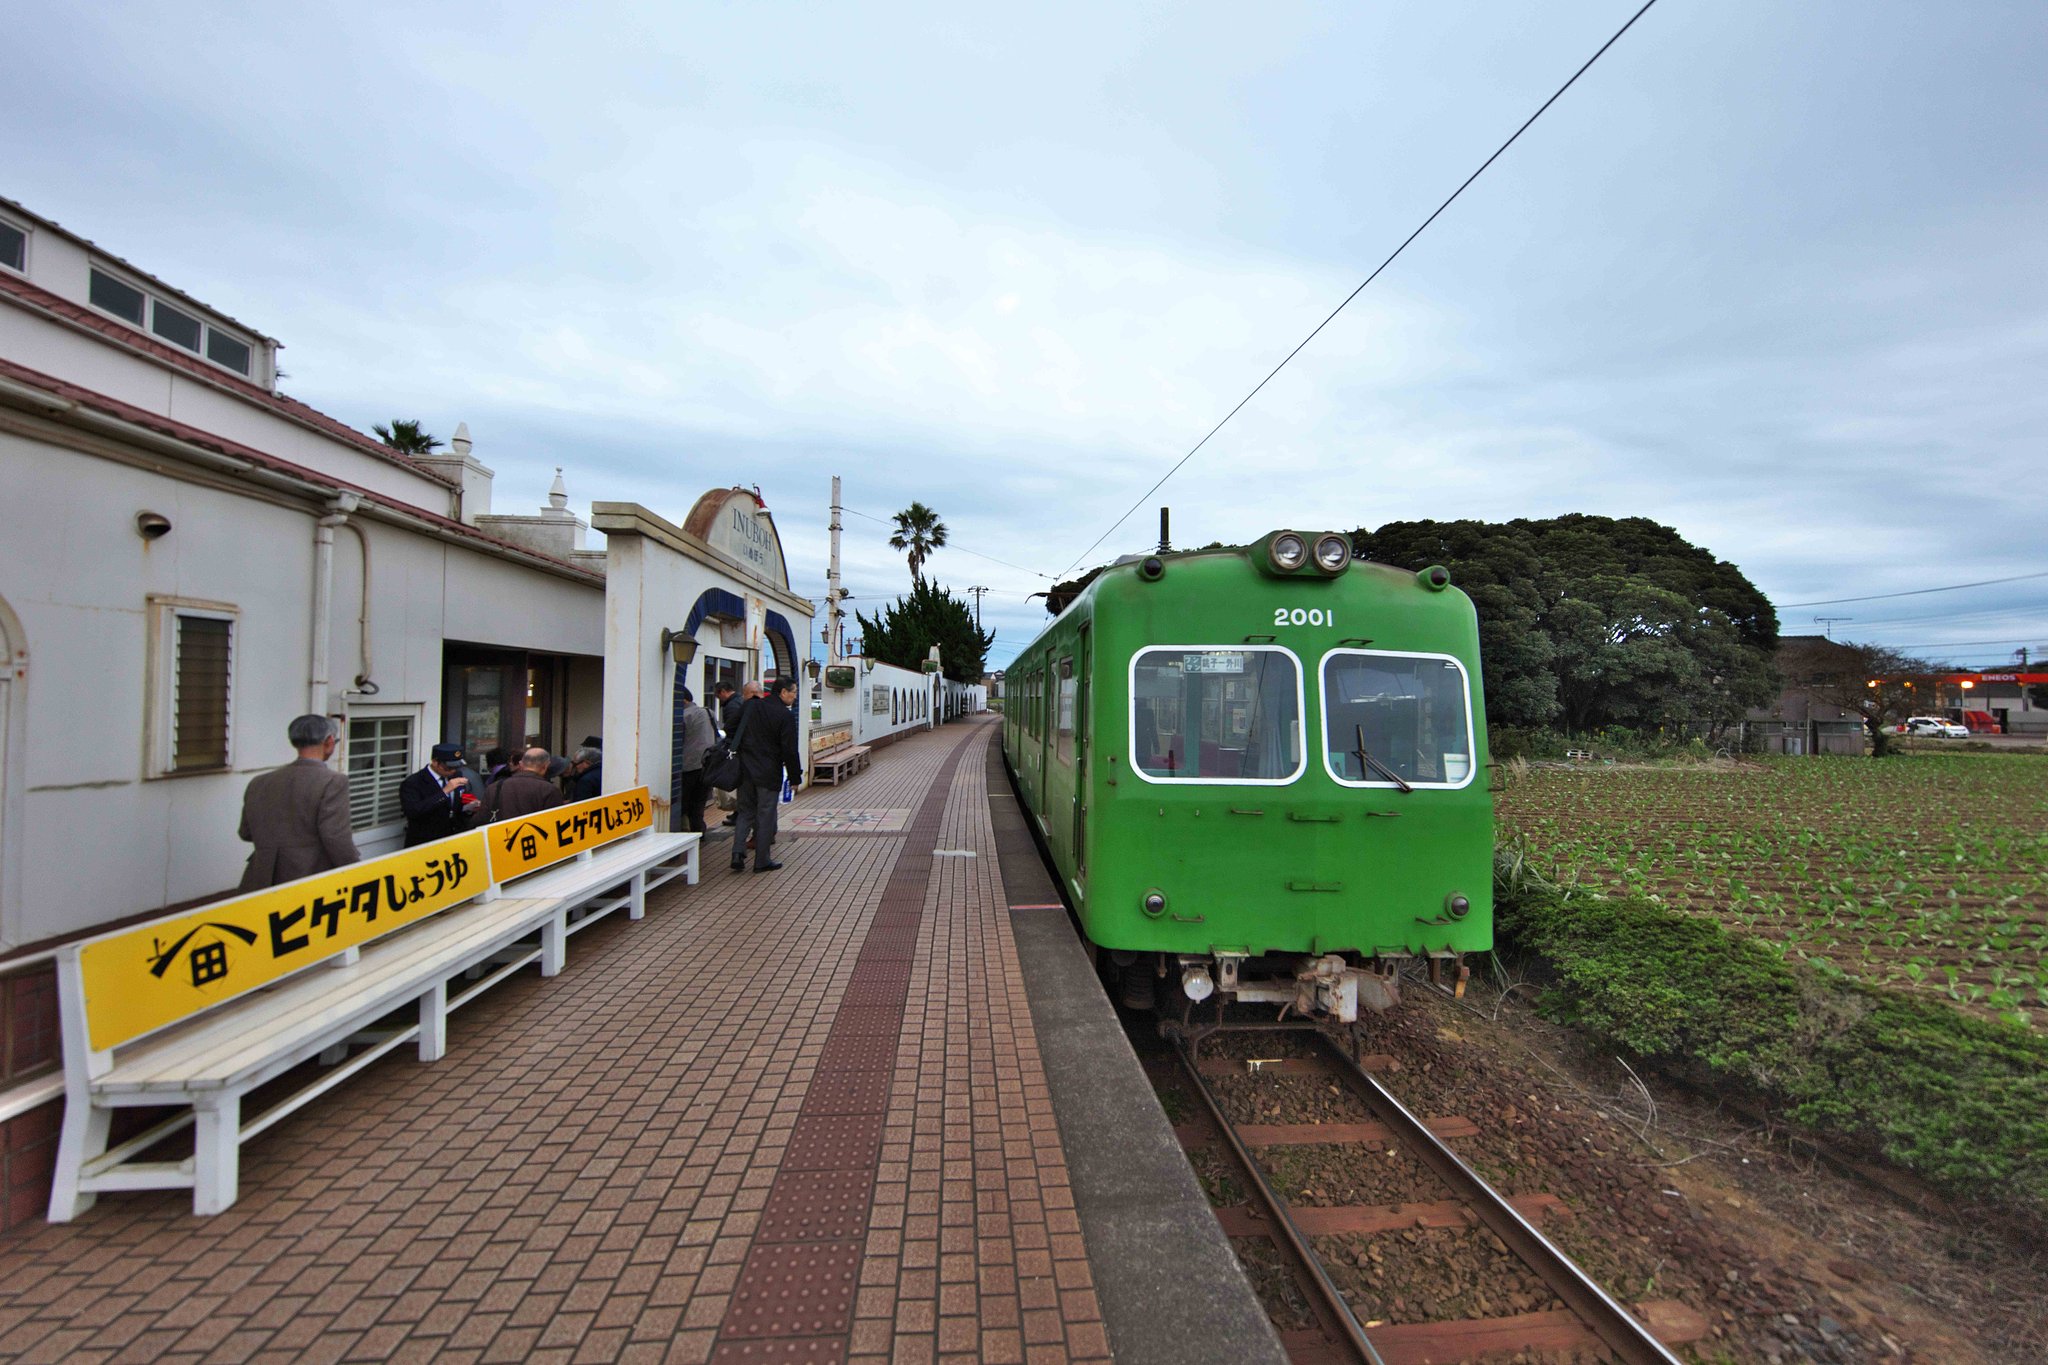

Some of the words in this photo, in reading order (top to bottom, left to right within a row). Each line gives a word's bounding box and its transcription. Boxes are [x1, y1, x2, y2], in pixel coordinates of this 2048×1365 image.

[732, 507, 772, 552] INUBOH
[1274, 608, 1333, 627] 2001
[556, 798, 644, 848] ヒゲタしょうゆ
[268, 852, 469, 959] ヒゲタしょうゆ
